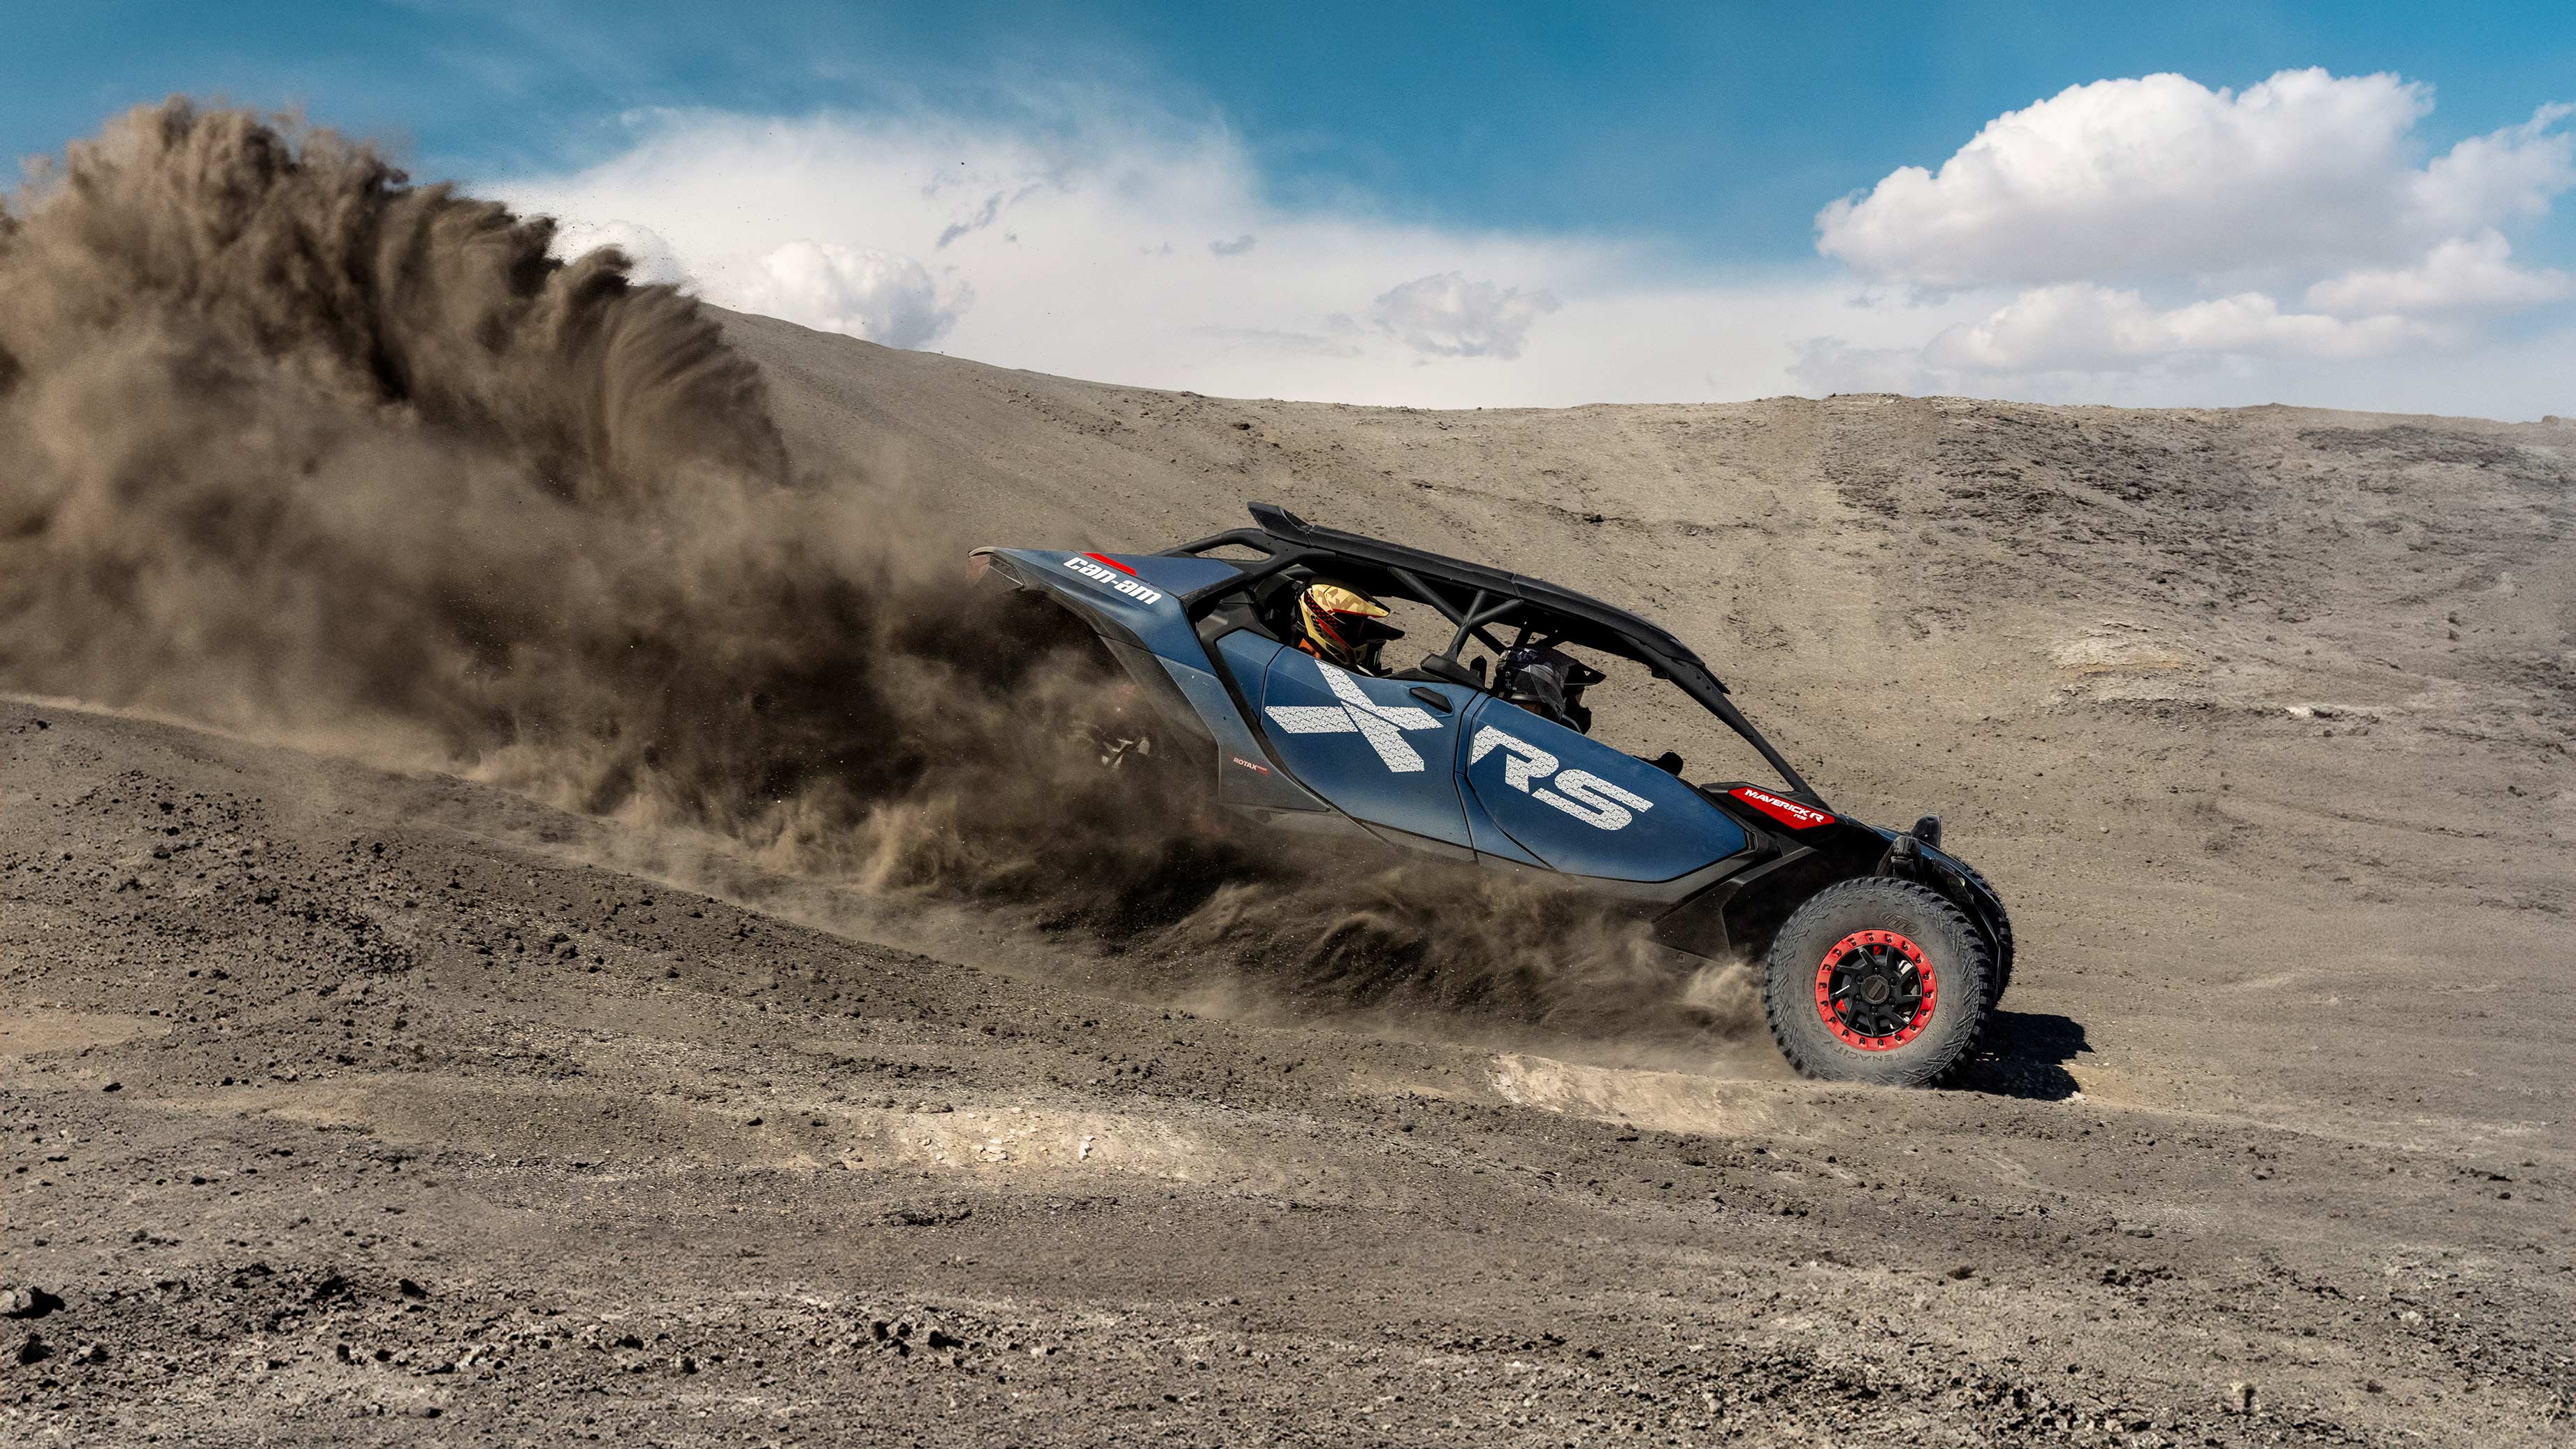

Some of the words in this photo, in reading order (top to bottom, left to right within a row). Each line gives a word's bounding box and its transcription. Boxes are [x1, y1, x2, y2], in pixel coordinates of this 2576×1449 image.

[1064, 557, 1162, 605] can-am
[1264, 659, 1444, 773] X
[1470, 724, 1654, 831] RS
[1233, 757, 1257, 770] ROTAX
[1744, 789, 1811, 816] MAVERICK
[1809, 812, 1824, 823] R
[1884, 914, 1920, 935] ITP
[1823, 1039, 1904, 1062] TENACITY
